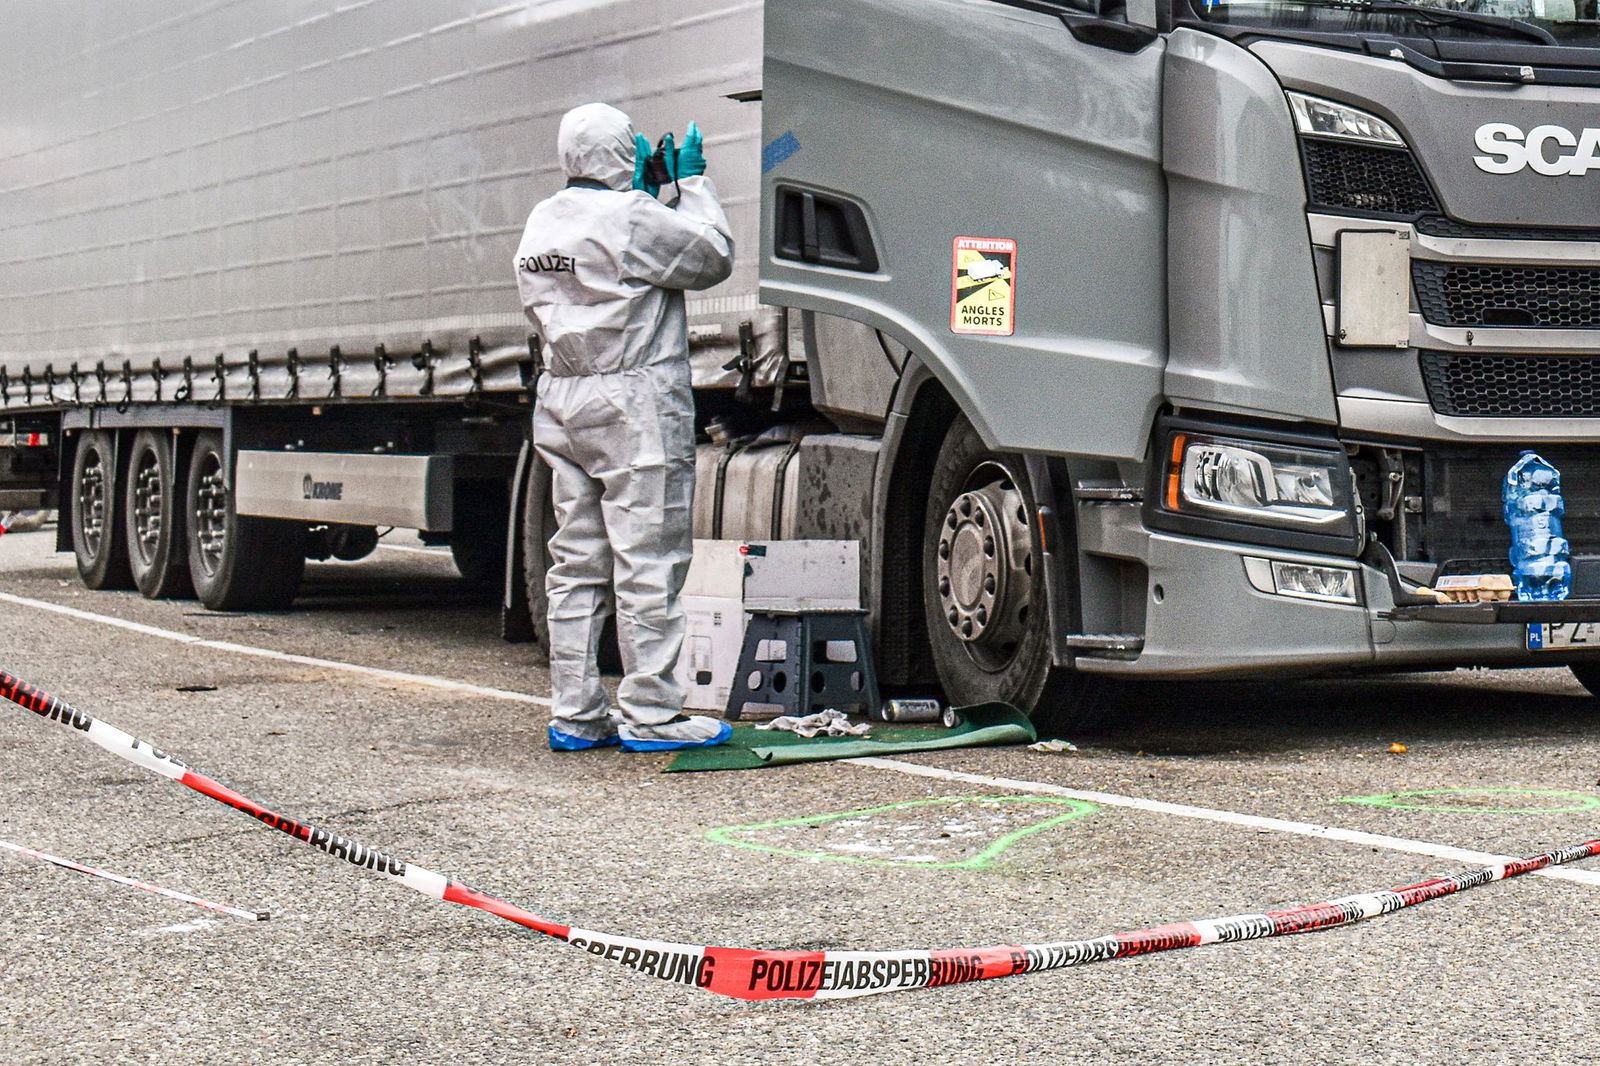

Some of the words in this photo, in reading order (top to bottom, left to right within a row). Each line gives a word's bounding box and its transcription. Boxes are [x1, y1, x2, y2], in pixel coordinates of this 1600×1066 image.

[1472, 122, 1600, 176] SCA
[957, 239, 1014, 251] ATTENTION
[519, 255, 576, 275] POLIZEI
[961, 305, 1005, 316] ANGLES
[963, 316, 1003, 327] MORTS
[1530, 632, 1540, 642] PL
[748, 956, 984, 991] POLIZEIABSPERRUNG
